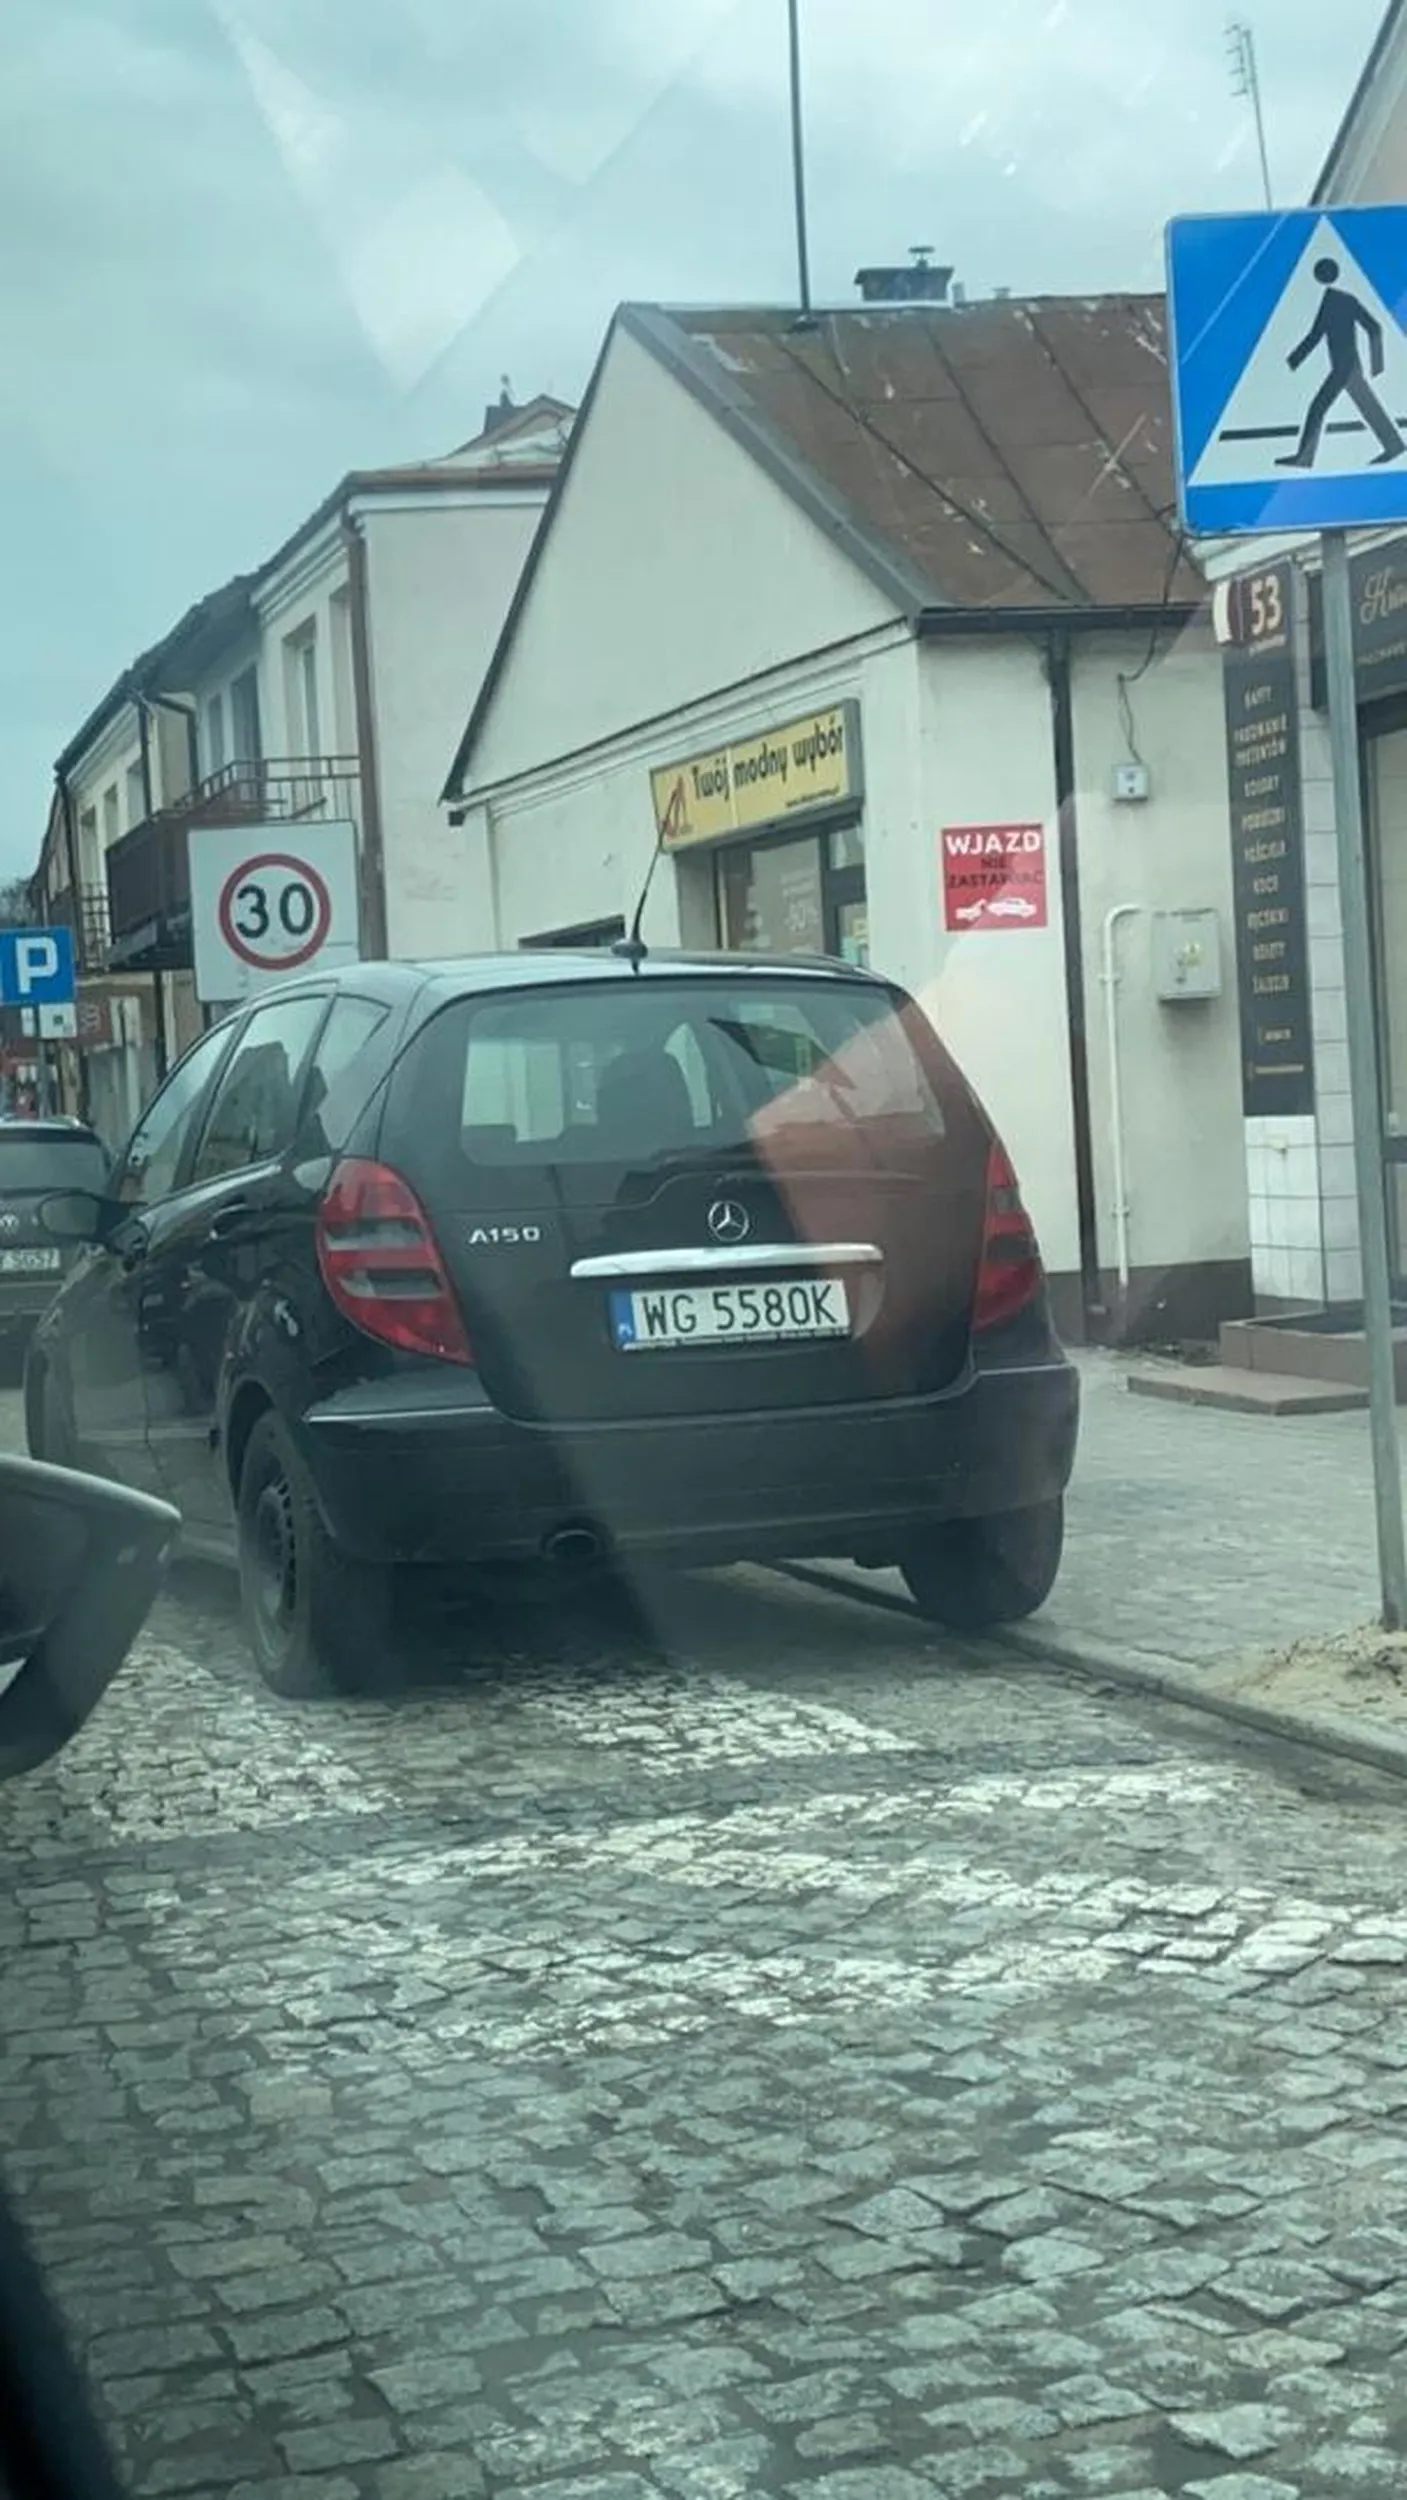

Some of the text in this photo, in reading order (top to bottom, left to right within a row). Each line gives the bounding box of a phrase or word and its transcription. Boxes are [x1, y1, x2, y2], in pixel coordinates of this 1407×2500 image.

[1250, 574, 1283, 636] 53
[691, 715, 844, 801] Twój modny wybór
[945, 831, 1041, 855] WJAZD
[236, 882, 314, 939] 30
[14, 936, 59, 994] P
[468, 1225, 541, 1244] A150
[641, 1294, 697, 1336] WG
